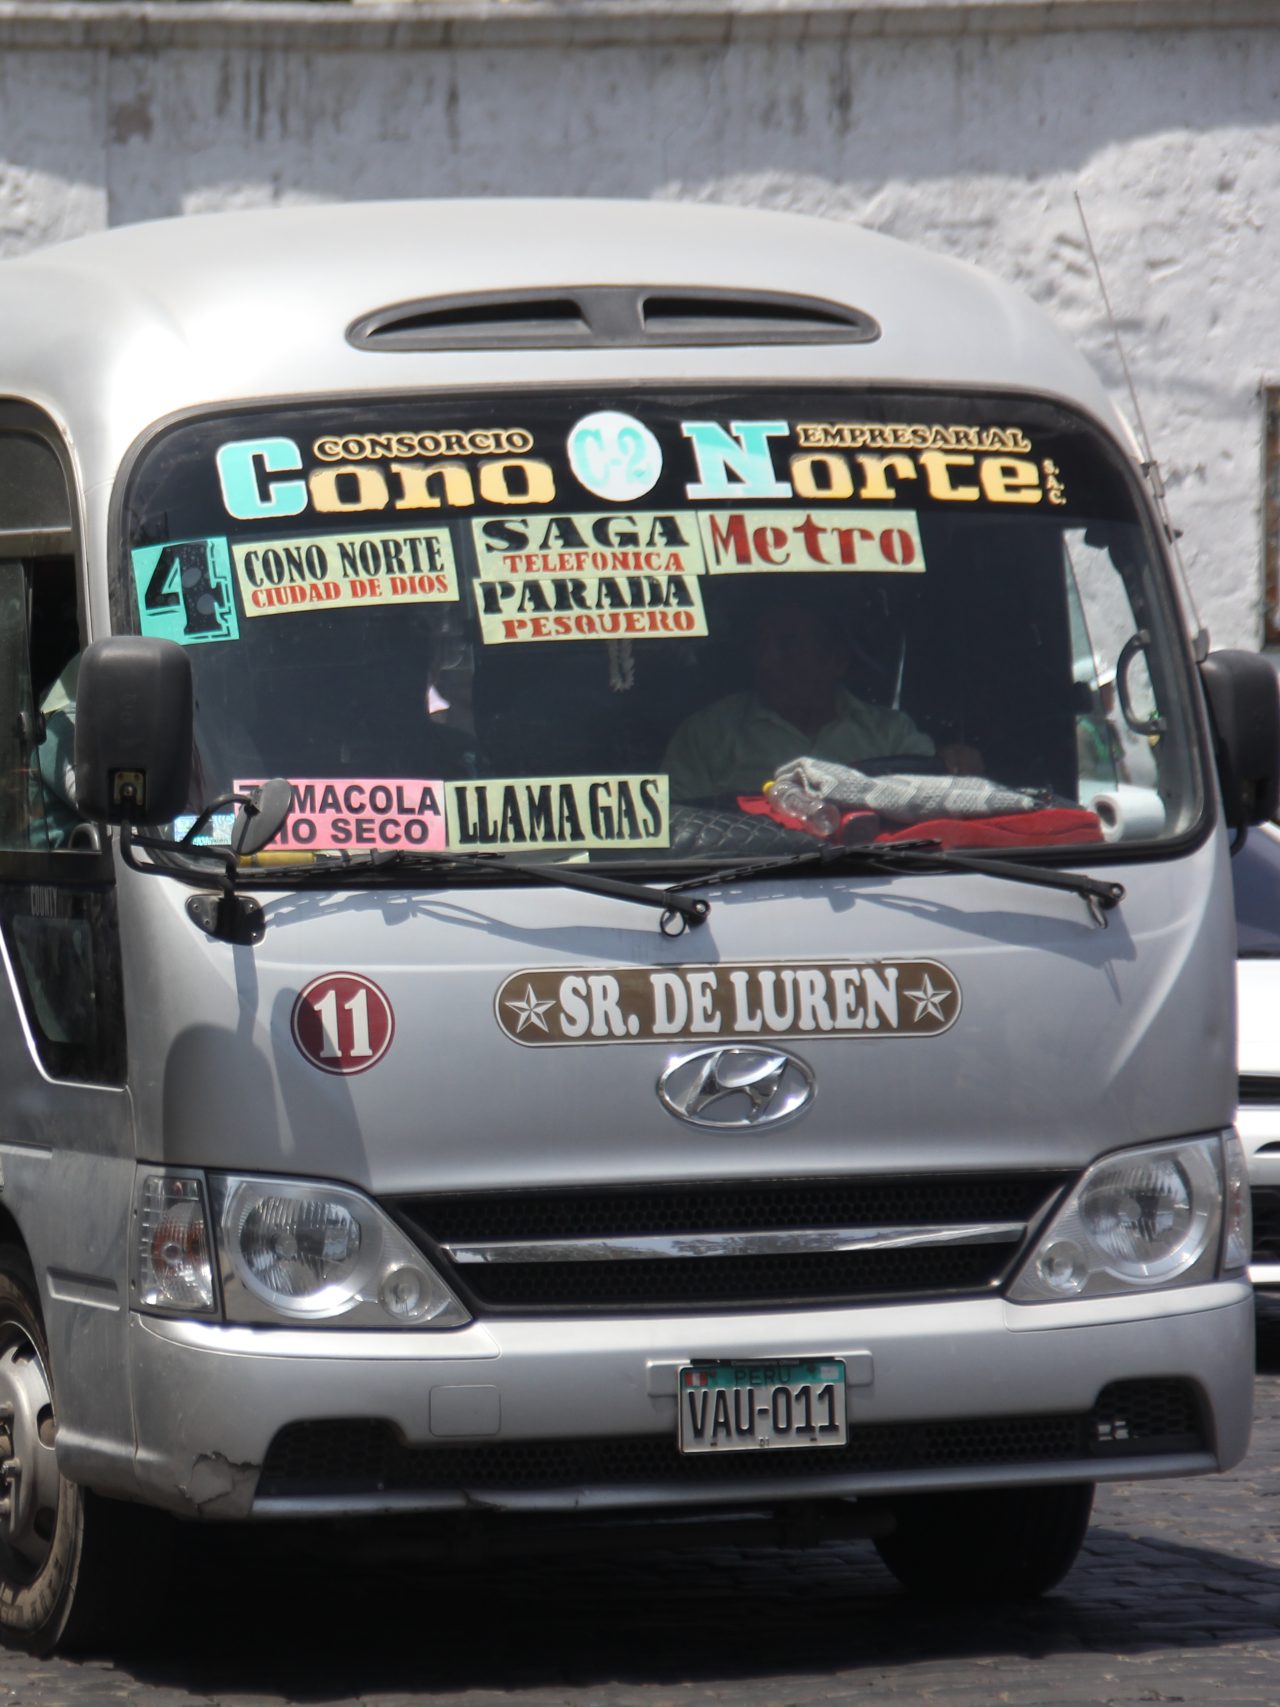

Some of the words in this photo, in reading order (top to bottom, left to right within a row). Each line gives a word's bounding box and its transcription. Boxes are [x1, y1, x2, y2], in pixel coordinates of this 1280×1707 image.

[313, 428, 534, 461] CONSORCIO
[795, 423, 1032, 453] EMPRESARIAL
[216, 436, 556, 520] Cono
[681, 420, 1043, 505] Norte
[482, 514, 690, 553] SAGA
[709, 513, 917, 567] Metro
[243, 544, 329, 588] CONO
[336, 536, 445, 580] NORTE
[502, 552, 686, 574] TELEFONICA
[144, 539, 230, 639] 4
[251, 578, 342, 609] CIUDAD
[350, 577, 383, 599] DE
[391, 574, 449, 596] DIOS
[479, 575, 695, 615] PARADA
[501, 610, 696, 640] PESQUERO
[239, 784, 441, 817] MACOLA
[453, 781, 586, 845] LLAMA
[588, 778, 665, 841] GAS
[271, 819, 317, 845] IO
[330, 818, 429, 845] SECO
[559, 975, 640, 1038] SR.
[649, 971, 720, 1035] DE
[730, 966, 900, 1034] LUREN
[313, 988, 374, 1059] 11
[687, 1383, 840, 1439] VAU-011
